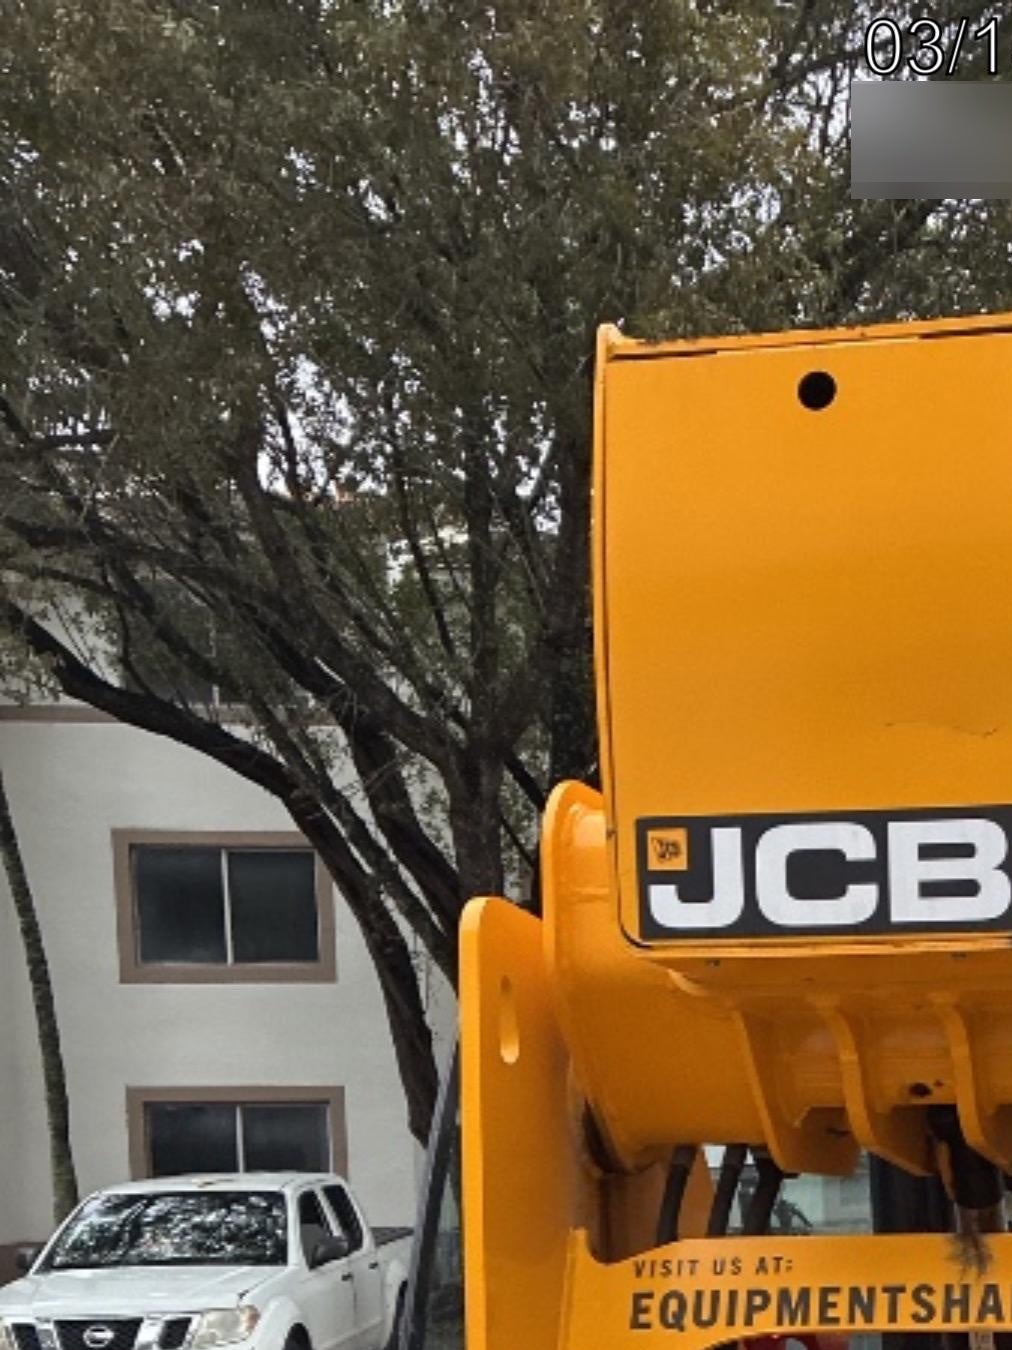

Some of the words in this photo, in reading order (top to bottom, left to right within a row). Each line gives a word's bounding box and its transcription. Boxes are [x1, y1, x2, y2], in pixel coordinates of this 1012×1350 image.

[648, 818, 1012, 929] JCB
[634, 1258, 699, 1278] VISIT
[713, 1256, 742, 1276] US
[755, 1256, 793, 1275] AT:
